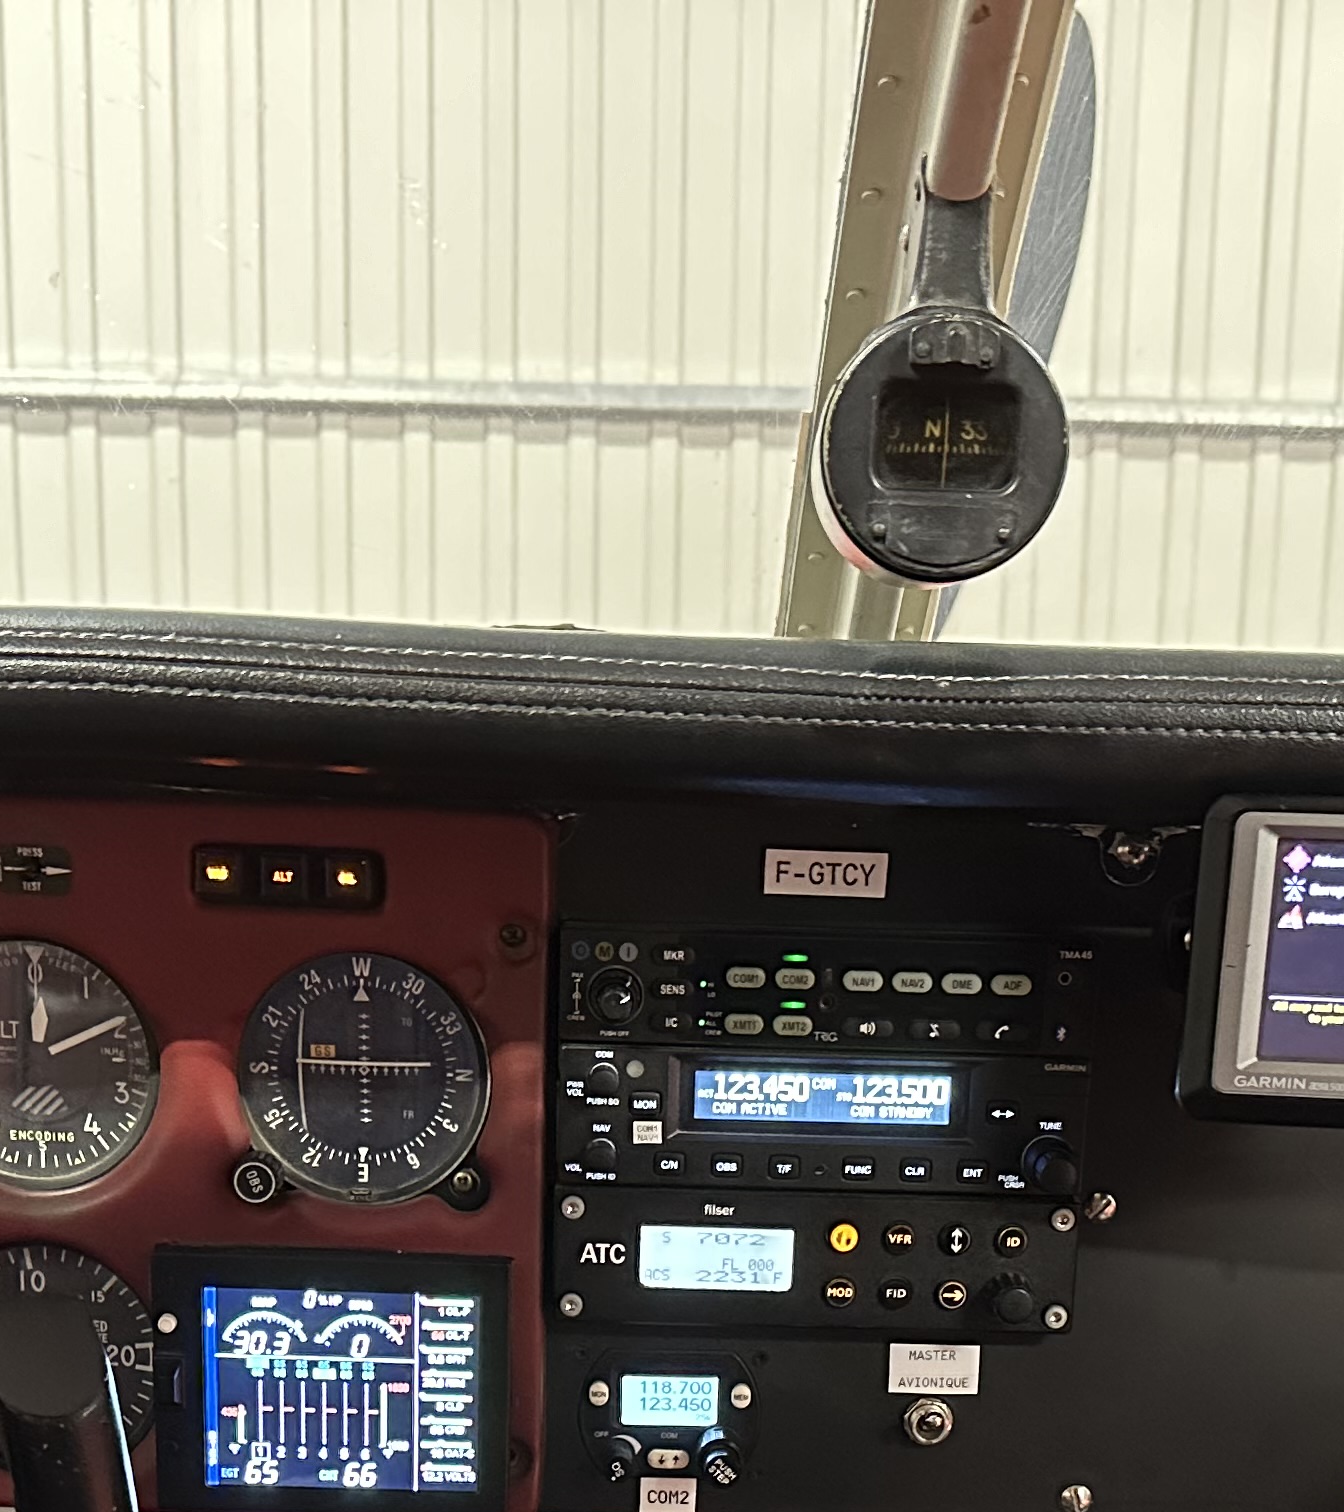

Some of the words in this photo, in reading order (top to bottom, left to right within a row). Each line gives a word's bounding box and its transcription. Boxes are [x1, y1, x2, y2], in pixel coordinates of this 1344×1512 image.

[776, 861, 876, 886] F-GTCY
[663, 951, 684, 961] MKR
[733, 974, 758, 983] COM1
[782, 976, 808, 984] COM2
[852, 978, 875, 986] NAV1
[901, 979, 924, 988] NAV2
[660, 985, 685, 995] SENS
[732, 1020, 757, 1030] XMT1
[781, 1022, 806, 1031] XMT2
[1045, 1063, 1086, 1072] GARMIN
[714, 1074, 810, 1102] 123.450
[634, 1100, 656, 1109] MON
[712, 1103, 736, 1113] COM
[740, 1103, 787, 1115] ACTIVE
[850, 1107, 874, 1117] COM
[879, 1107, 933, 1118] STANDBY
[1040, 1122, 1062, 1130] TUNE
[10, 1130, 74, 1142] ENCODING
[716, 1163, 737, 1172] OBS
[845, 1166, 872, 1174] FUNC
[963, 1169, 983, 1177] ENT
[704, 1204, 735, 1215] filser
[663, 1232, 671, 1243] S
[697, 1233, 765, 1246] 7072
[889, 1234, 912, 1244] VFR
[1007, 1237, 1020, 1246] ID
[580, 1243, 626, 1264] ATC
[827, 1288, 853, 1298] MOD
[886, 1289, 906, 1298] FID
[234, 1330, 290, 1355] 30.3
[909, 1351, 956, 1361] MASTER
[641, 1381, 712, 1394] 118.700
[898, 1378, 969, 1388] AVIONIQUE
[640, 1398, 712, 1411] 123.450
[221, 1468, 239, 1478] EGT
[244, 1460, 279, 1484] 65
[647, 1490, 689, 1504] COM2
